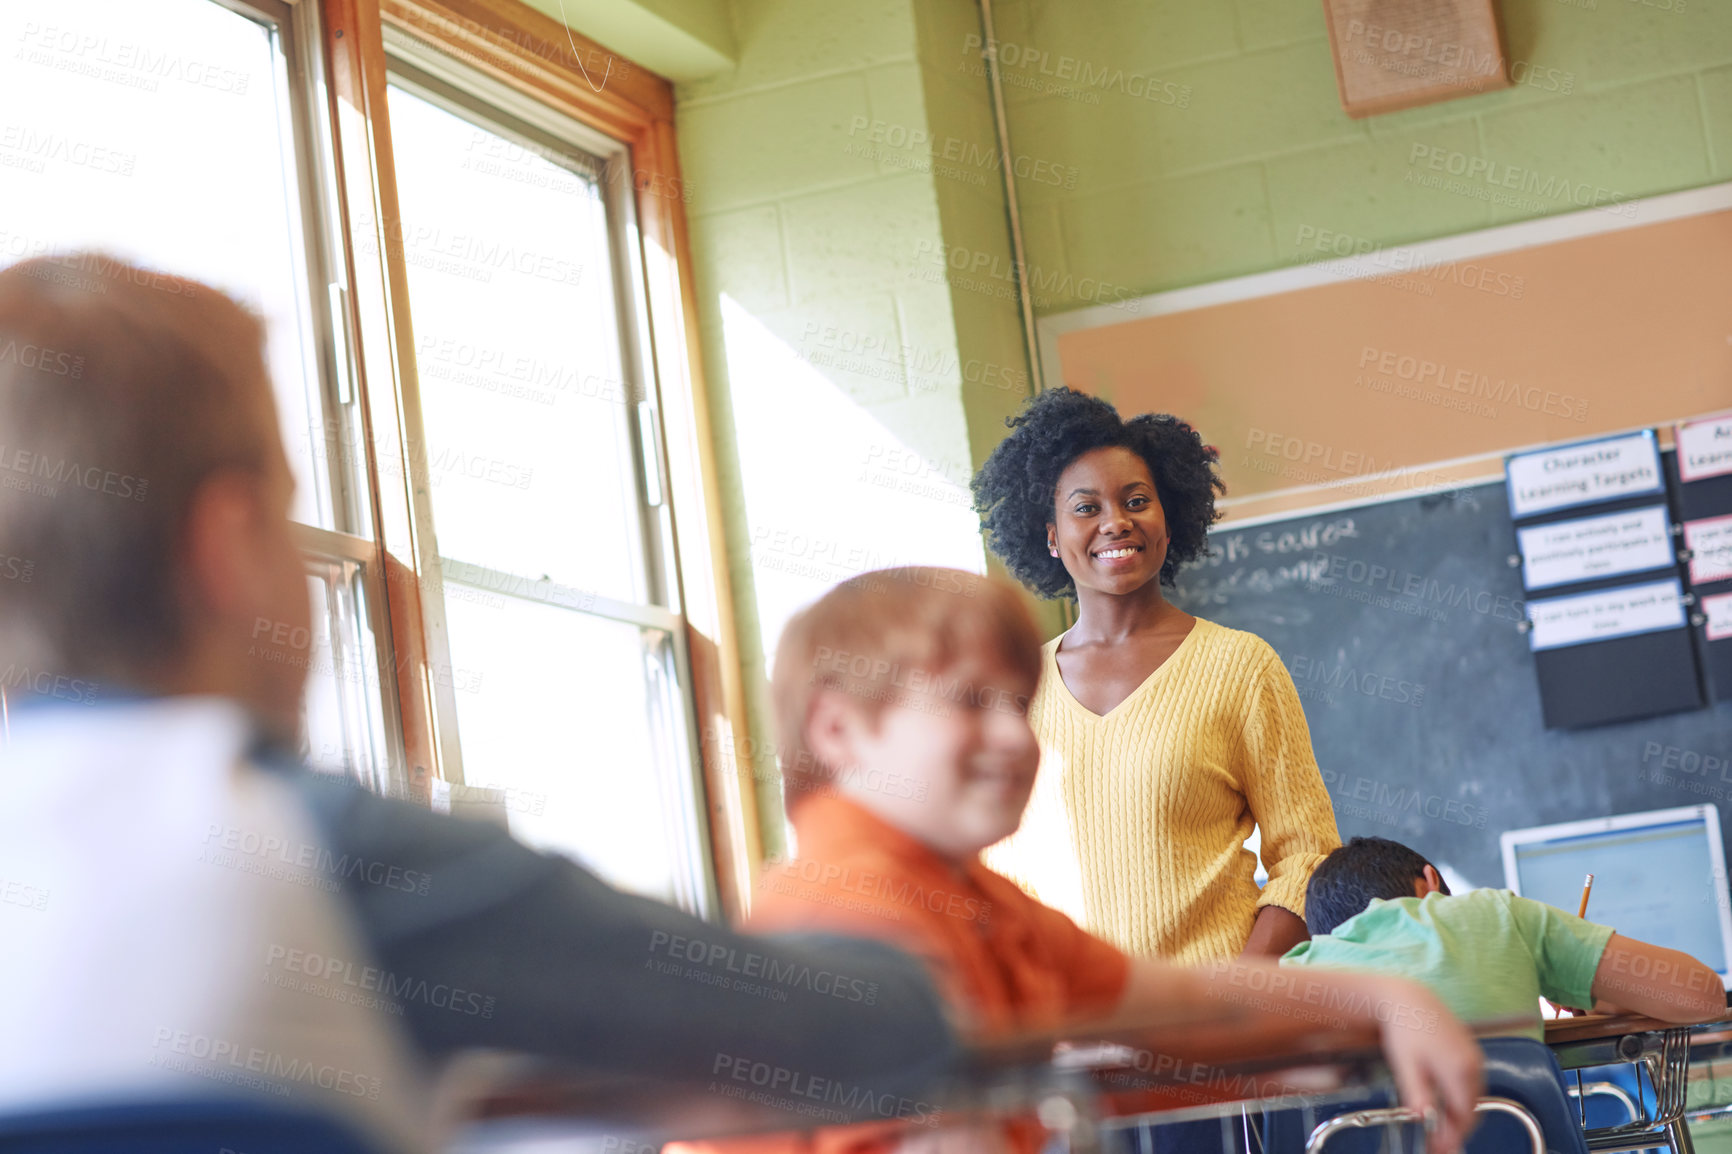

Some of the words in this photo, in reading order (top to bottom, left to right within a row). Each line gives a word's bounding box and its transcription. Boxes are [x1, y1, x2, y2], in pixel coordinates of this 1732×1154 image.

[1543, 448, 1621, 472] Character
[1520, 479, 1588, 501] Learning
[1594, 466, 1652, 486] Targets
